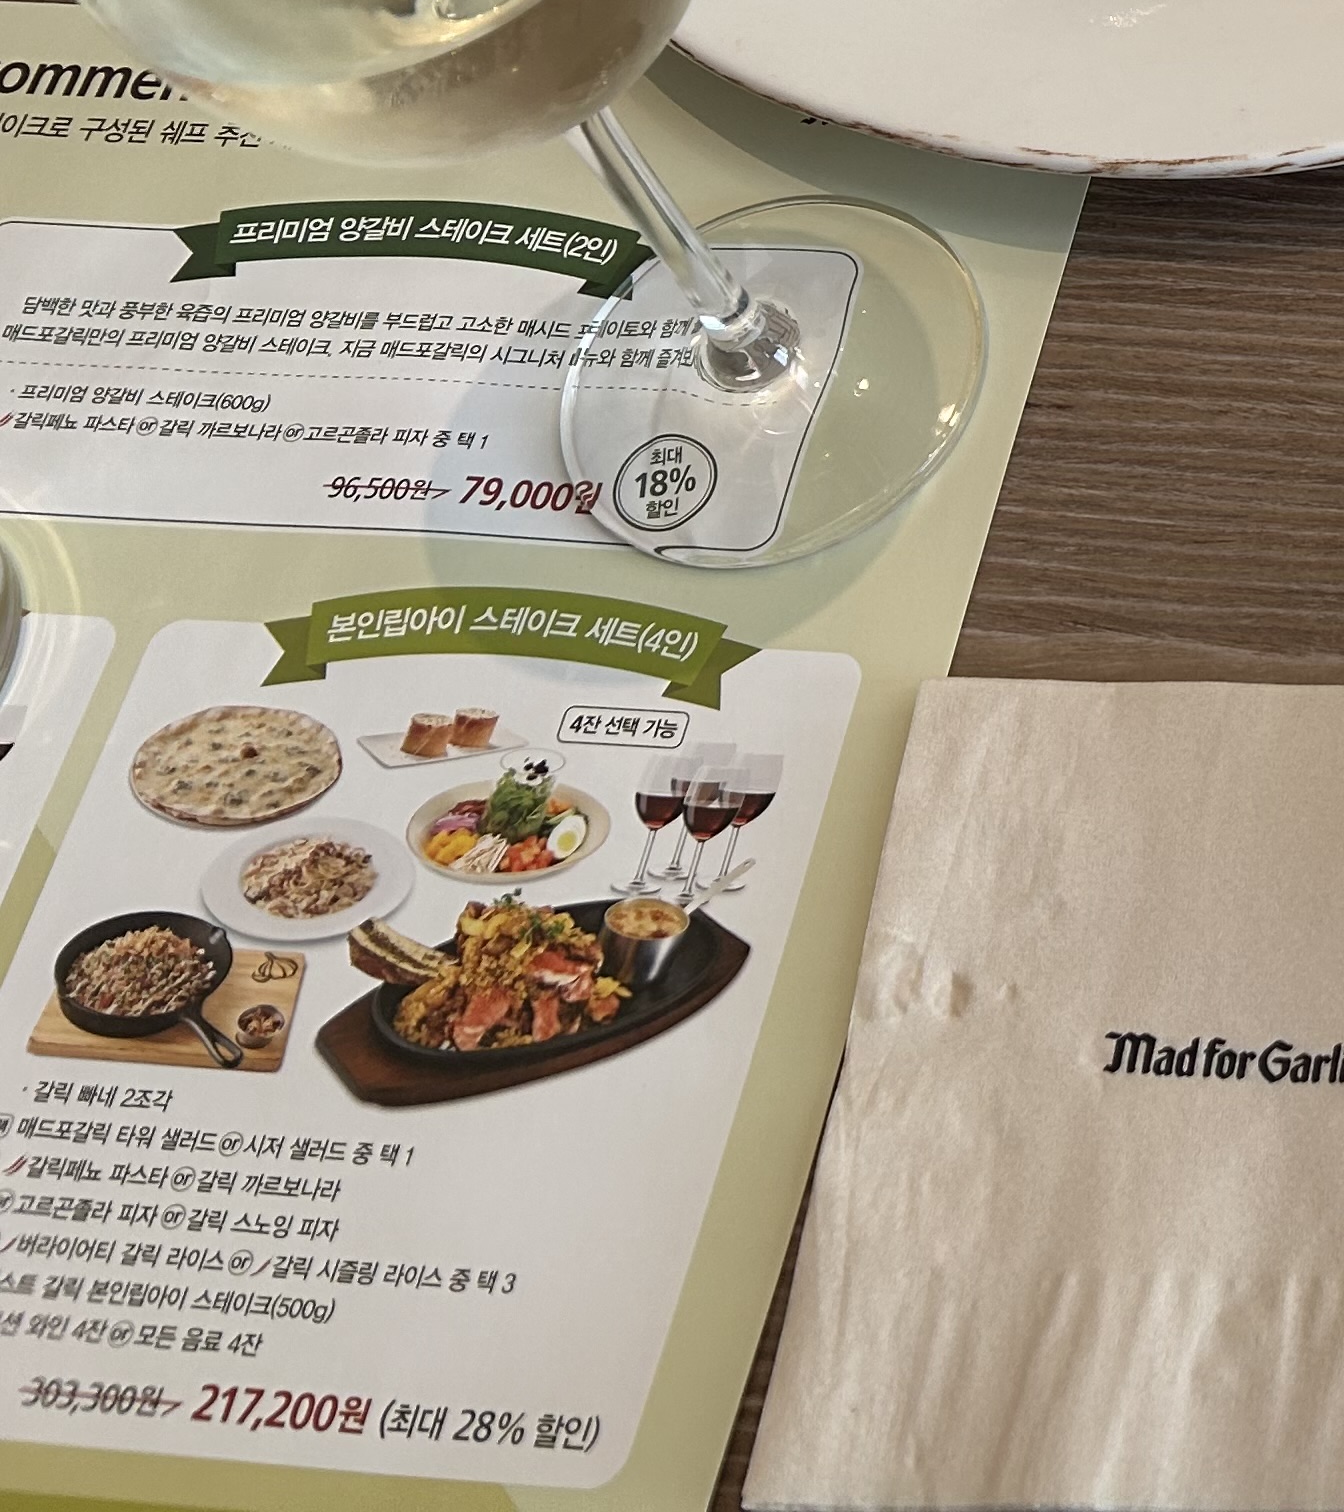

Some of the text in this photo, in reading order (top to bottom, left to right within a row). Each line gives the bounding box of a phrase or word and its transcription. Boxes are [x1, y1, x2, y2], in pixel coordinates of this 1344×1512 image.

[0, 112, 74, 138] 이크로
[80, 117, 155, 144] 구성된
[160, 120, 210, 146] 쉐프
[229, 216, 618, 266] 프리미엄 양갈비 스테이크 세트(2인)
[21, 296, 77, 317] 담백한
[81, 300, 116, 319] 맛과
[119, 301, 174, 320] 풍부한
[176, 302, 232, 323] 육즙의
[232, 307, 306, 328] 프리미엄
[310, 309, 379, 330] 양갈비를
[382, 311, 453, 331] 부드럽고
[455, 316, 513, 336] 고소한
[517, 318, 572, 338] 매시드
[1, 324, 125, 348] 매드포갈릭만의
[125, 329, 199, 351] 프리미엄
[202, 333, 257, 354] 양갈비
[340, 338, 377, 358] 지금
[379, 340, 488, 364] 매드포갈릭의
[490, 347, 565, 369] 시그니처
[621, 347, 654, 369] 함께
[18, 384, 272, 413] 프리미엄 양갈비 스테이크(600g)
[13, 412, 429, 446] 갈릭페뇨 파스타 갈릭 까르보나라 고르곤졸라 피자
[650, 447, 683, 465] 최대
[635, 465, 697, 499] 18%
[645, 501, 680, 520] 할인
[328, 605, 699, 662] 본인립아이 스테이크 세트(4인)
[569, 714, 678, 739] 4잔 선택 가능
[1104, 1032, 1199, 1079] Mad
[1201, 1038, 1256, 1079] for
[33, 1081, 173, 1112] 갈릭 빠네 2조각
[17, 1117, 347, 1162] 매드포갈릭 타워 샐러드 시저 샐러드
[13, 1193, 339, 1242] 고르곤졸라 피자 갈릭 스노잉 피자
[16, 1234, 517, 1294] 버라이어티 갈릭 라이스 갈릭 시즐링 라이스 중 택 3
[42, 1274, 336, 1324] 갈릭 본인립아이 스테이크(500g)
[191, 1383, 372, 1436] 217,200원
[379, 1399, 445, 1440] (최대
[452, 1409, 525, 1446] 28%
[533, 1413, 601, 1452] 할인)
